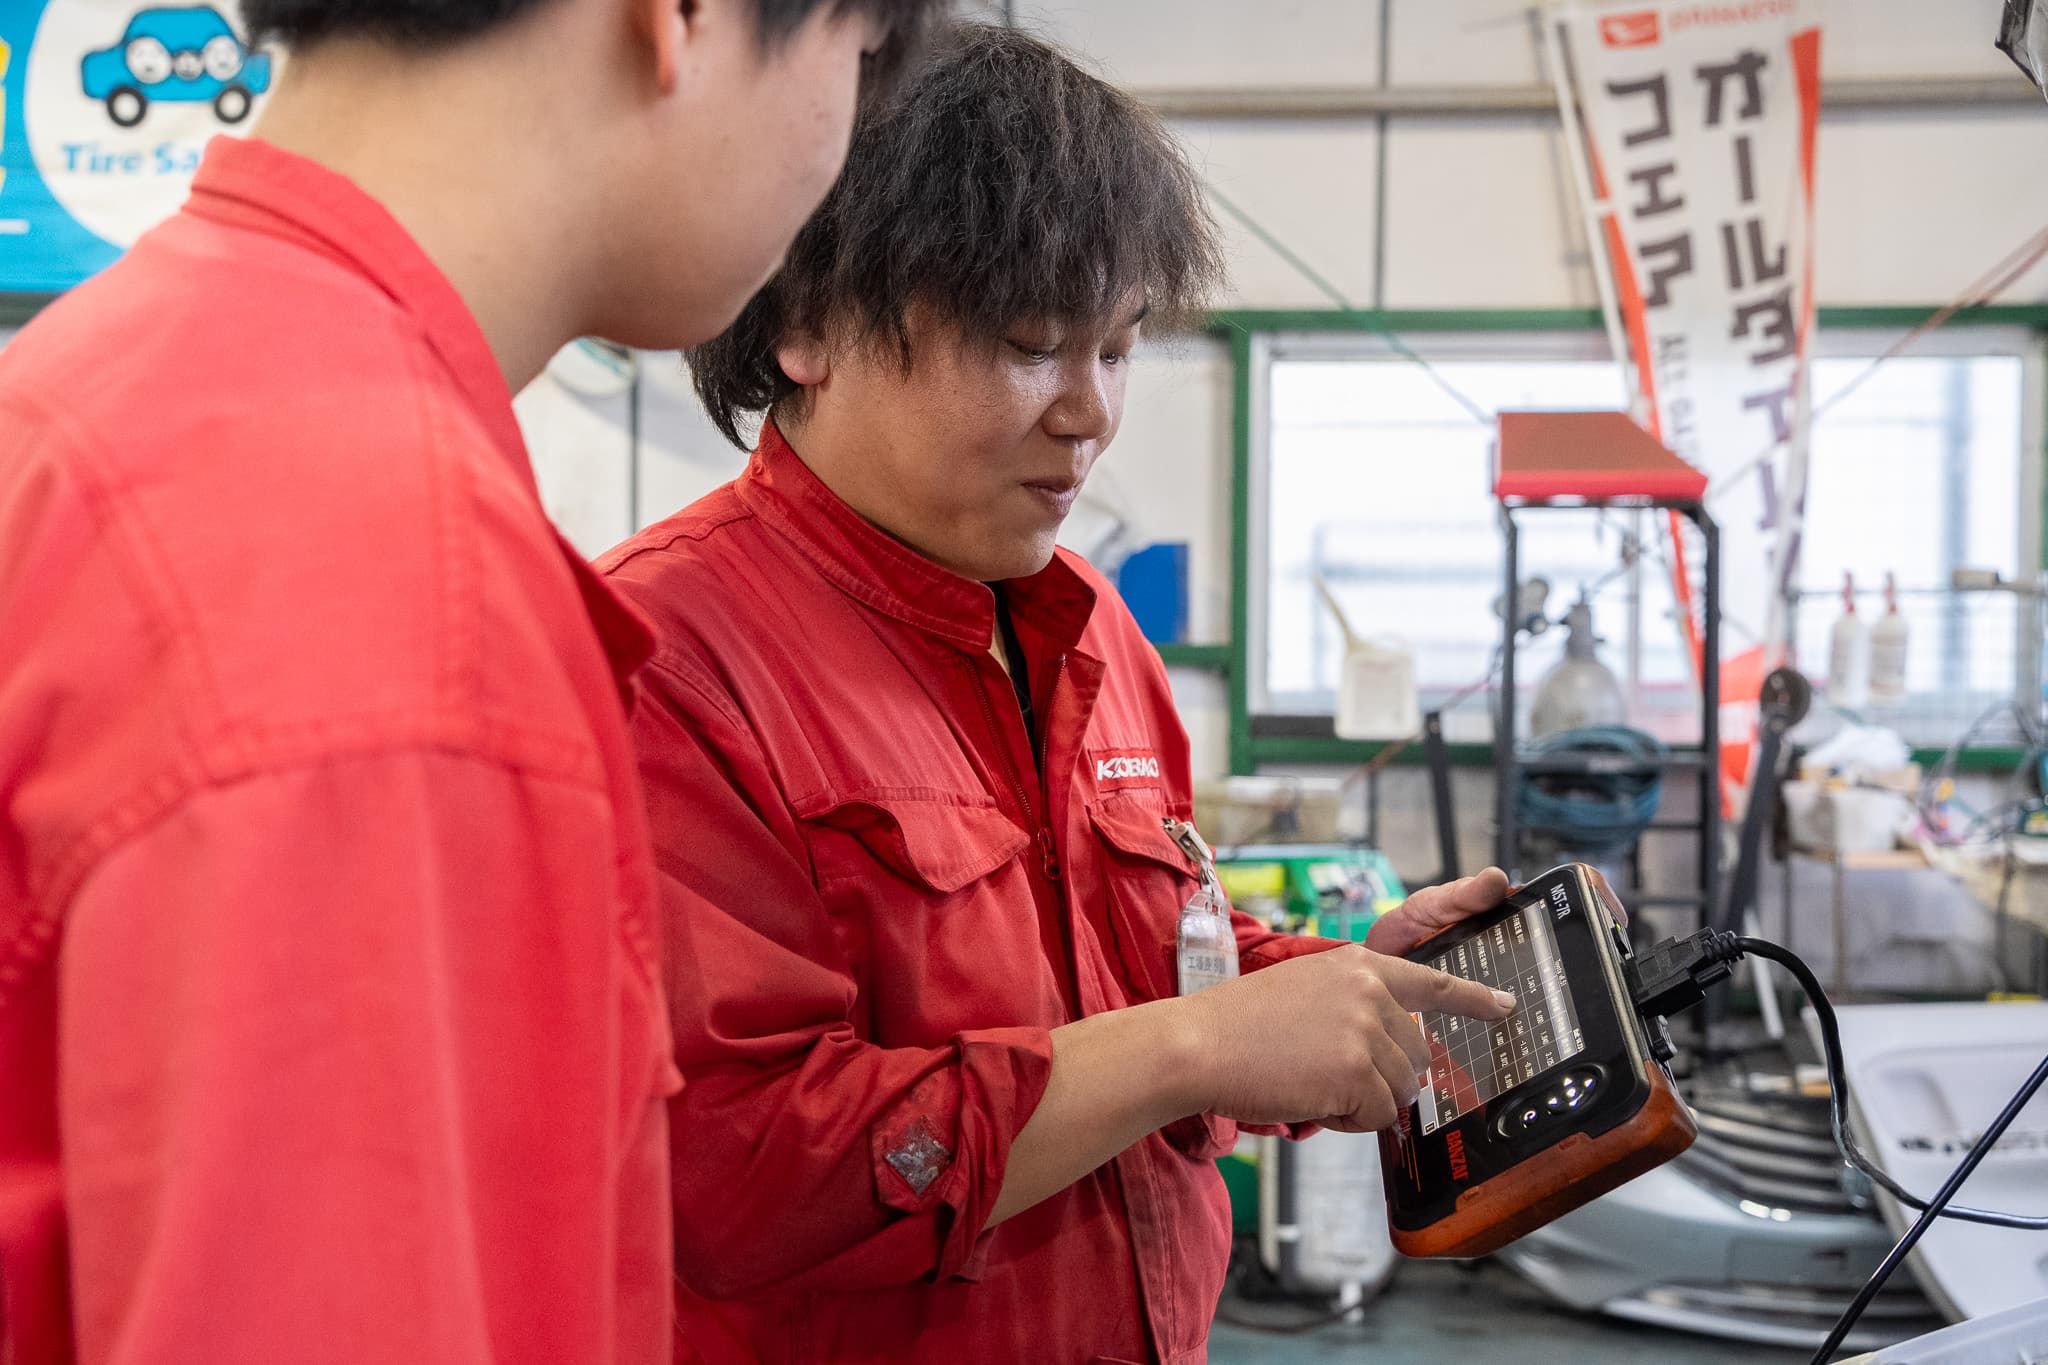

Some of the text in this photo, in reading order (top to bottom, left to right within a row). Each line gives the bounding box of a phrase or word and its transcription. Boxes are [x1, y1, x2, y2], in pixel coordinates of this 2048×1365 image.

[62, 143, 142, 174] Tire
[1550, 883, 1571, 920] MST-7R
[1446, 1129, 1469, 1181] BANZAI
